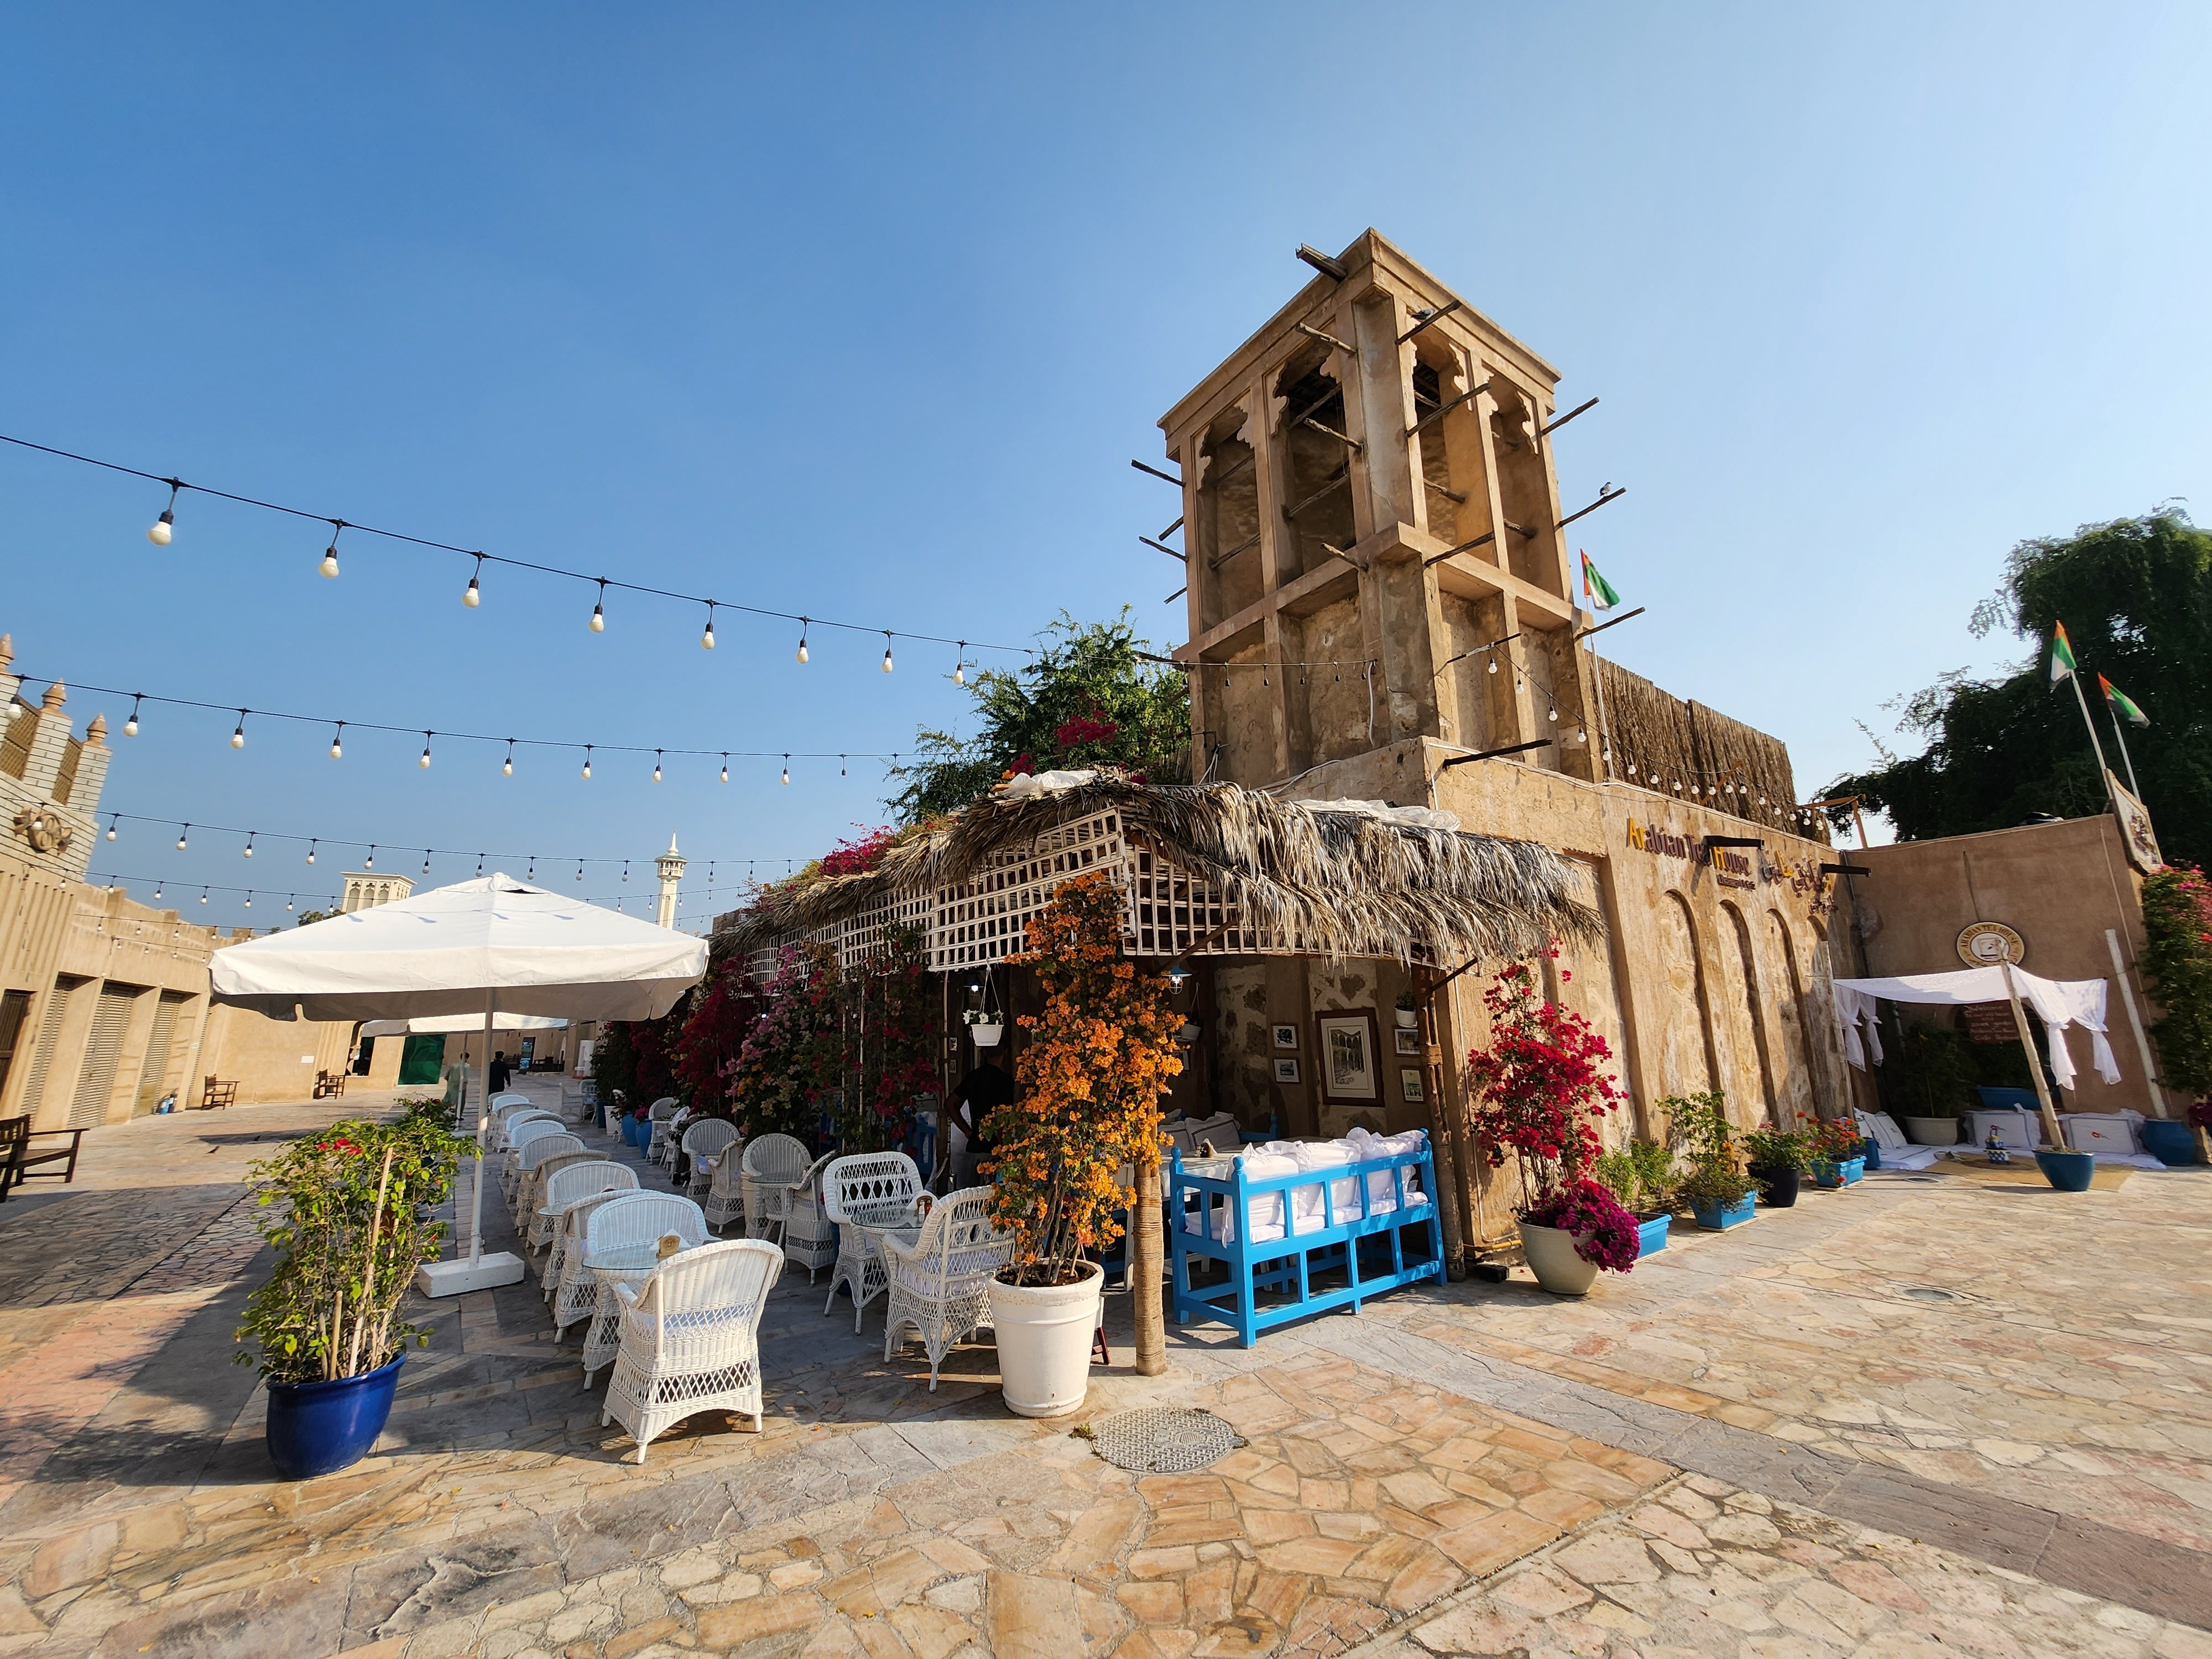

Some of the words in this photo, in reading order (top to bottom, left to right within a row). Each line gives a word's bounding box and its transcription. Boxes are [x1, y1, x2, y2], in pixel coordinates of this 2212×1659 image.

[1625, 817, 1687, 859] Arabian
[1712, 846, 1751, 877] House
[1960, 927, 1981, 947] ARABIAN
